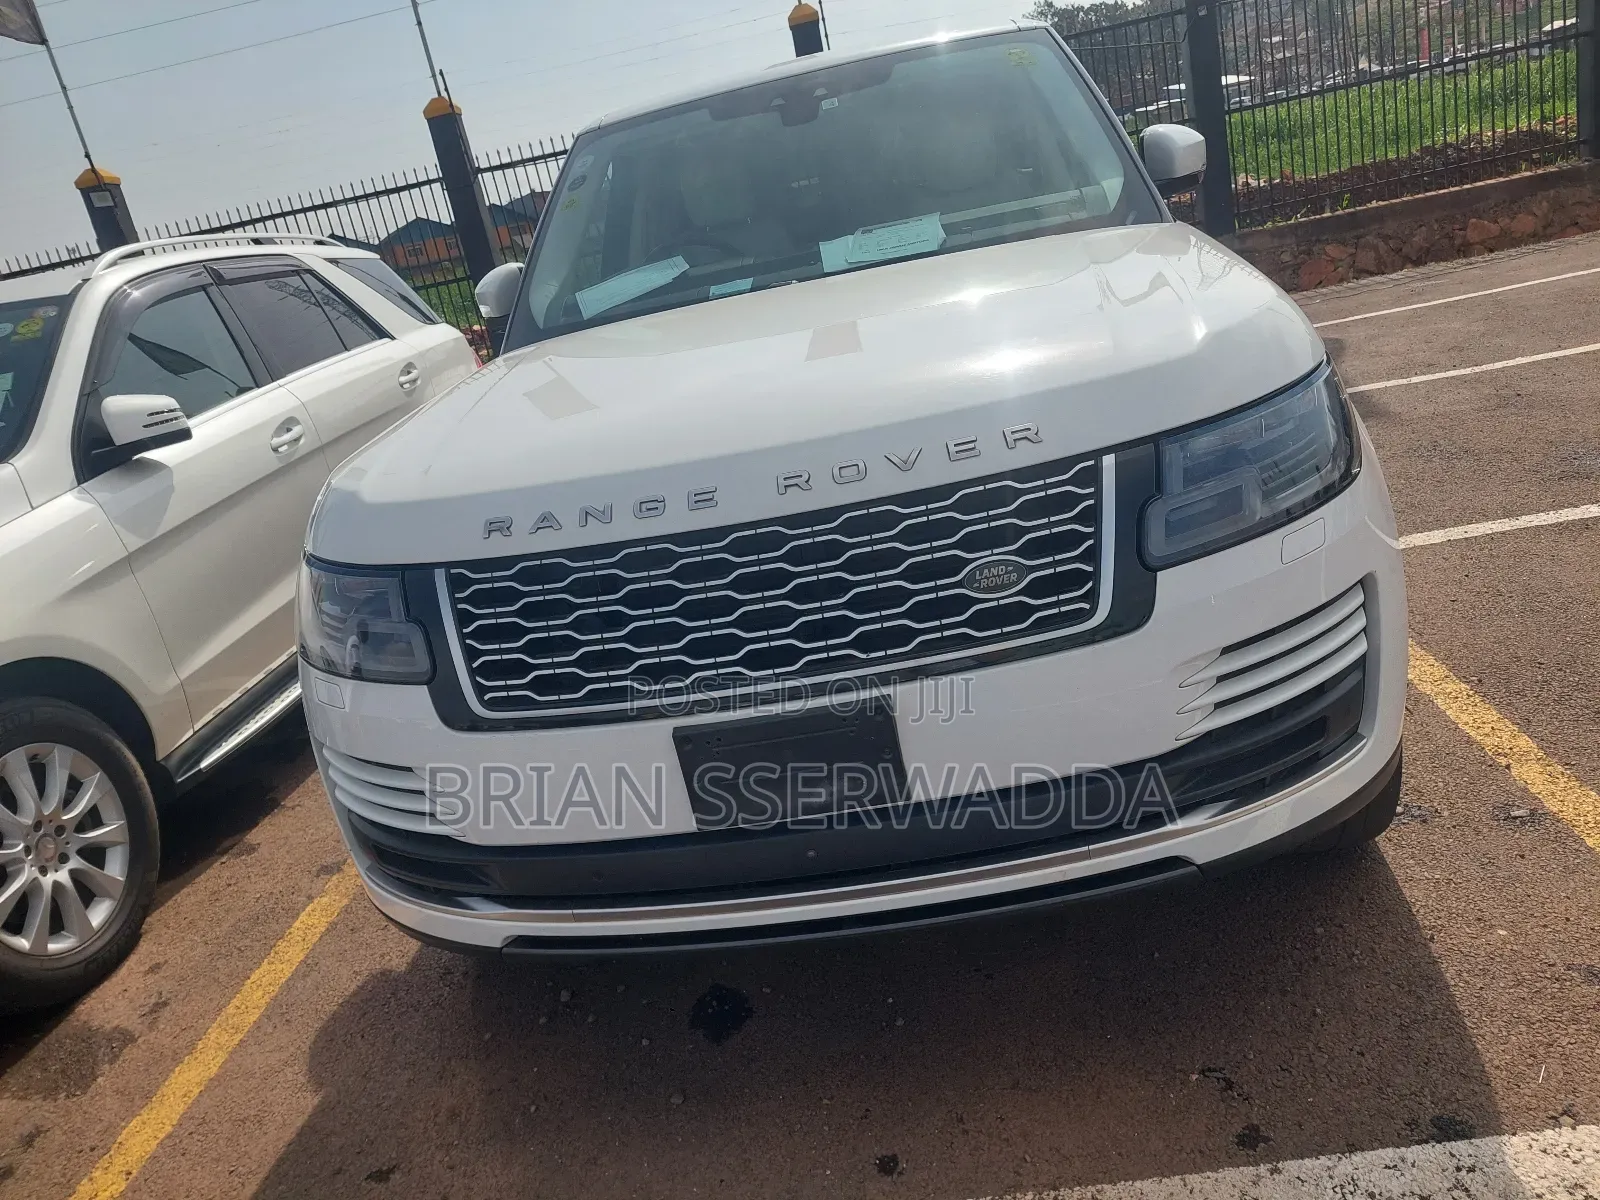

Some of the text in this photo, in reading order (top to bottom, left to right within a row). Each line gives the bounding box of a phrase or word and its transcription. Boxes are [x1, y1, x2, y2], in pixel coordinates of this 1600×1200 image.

[482, 422, 1044, 540] RANGE ROVER
[975, 565, 1006, 580] LAND
[980, 572, 1018, 589] ROVER
